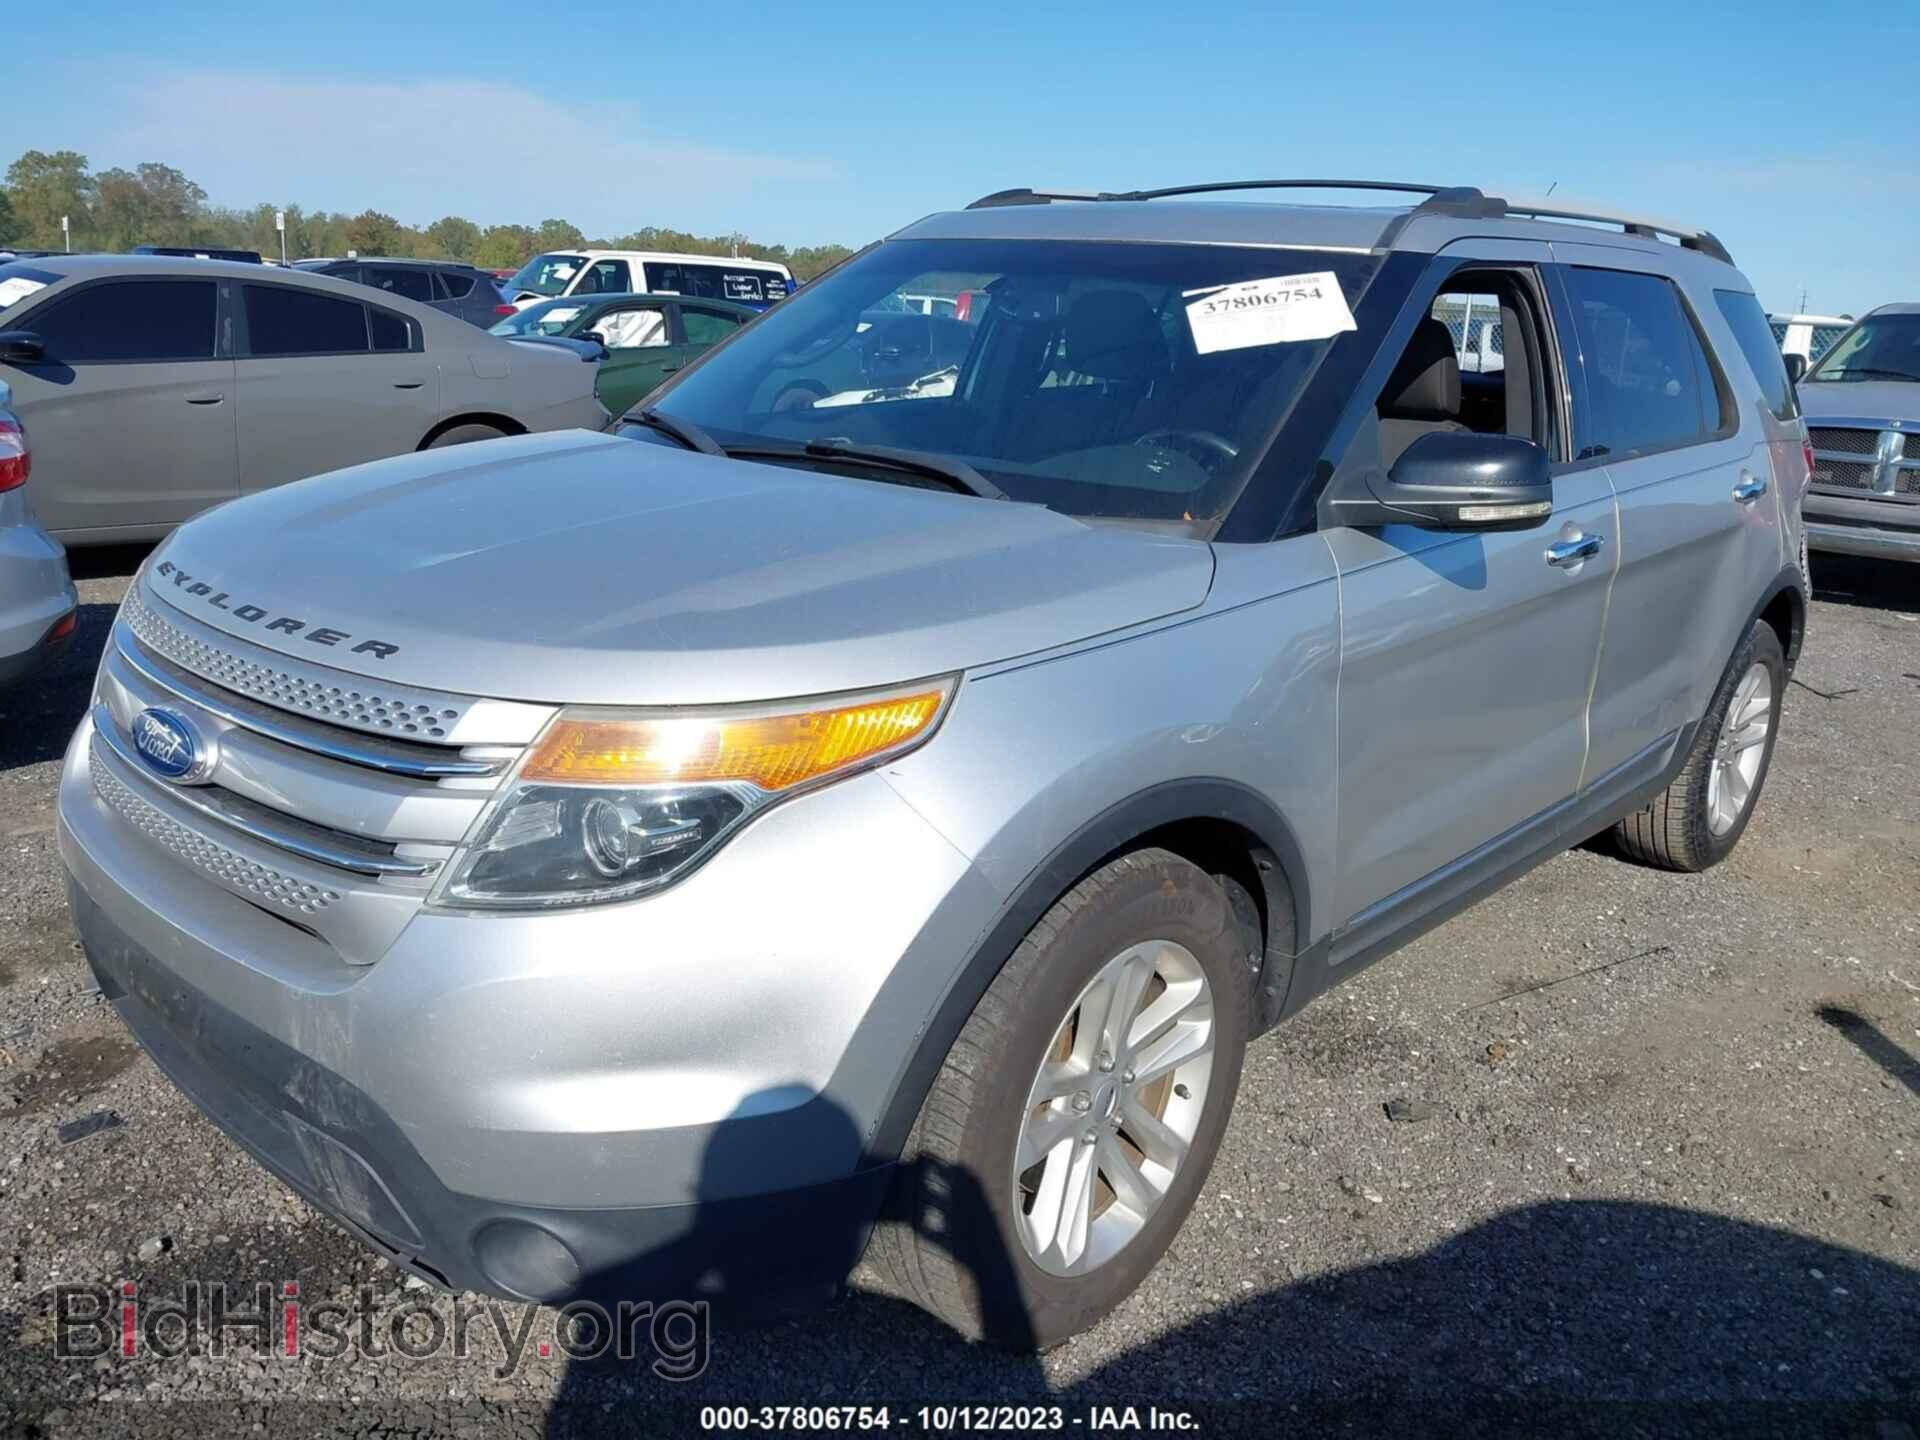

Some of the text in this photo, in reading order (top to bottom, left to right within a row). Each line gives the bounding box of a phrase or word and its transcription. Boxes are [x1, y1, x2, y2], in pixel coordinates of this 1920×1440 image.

[1203, 287, 1323, 315] 37806754
[156, 560, 400, 660] EXPLORER
[138, 718, 182, 764] Ford
